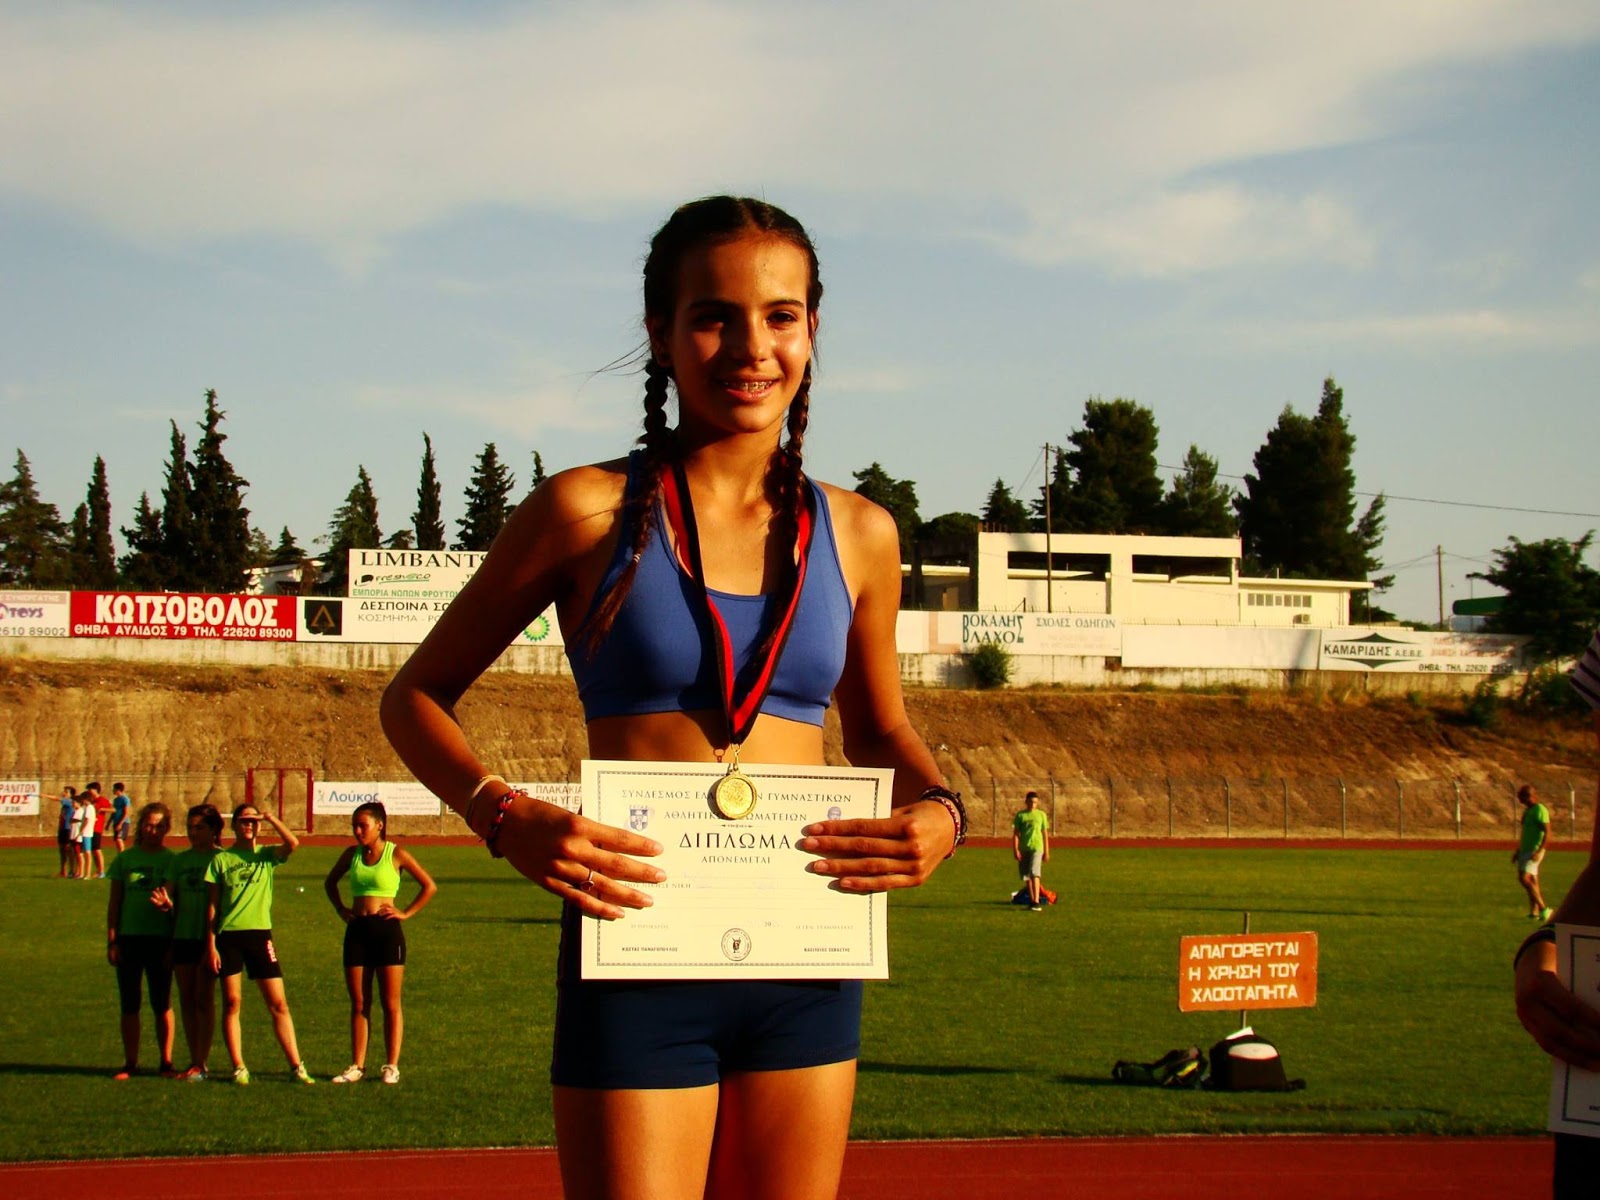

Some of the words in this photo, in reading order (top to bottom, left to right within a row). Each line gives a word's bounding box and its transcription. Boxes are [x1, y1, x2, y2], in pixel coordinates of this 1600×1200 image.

[352, 588, 389, 596] ΕΜΠΟΡΙΑ
[95, 595, 278, 627] ΚΩΤΣΟΒΟΛΟΣ
[360, 601, 428, 611] ΔΕΣΠΟΙΝΑ
[358, 613, 418, 622] ΚΟΣΜΗΜΑ
[1036, 617, 1071, 628] ΣΧΟΛΕΣ
[1075, 617, 1116, 628] ΟΔΗΓΩΝ
[0, 626, 25, 636] 610
[29, 627, 66, 636] 89002
[74, 624, 110, 635] ΘΗΒΑ
[115, 625, 168, 636] ΑΥΛΙΔΟΣ
[173, 626, 188, 636] 79
[193, 626, 220, 637] ΤΗΛ.
[222, 626, 257, 638] 22620
[259, 627, 293, 638] 89300
[1323, 645, 1392, 656] ΚΑΜΑΡΙΔΗΣ
[329, 790, 379, 803] Λούκος
[621, 789, 690, 799] ΣΥΝΔΕΣΜΟΣ
[768, 792, 851, 802] ΓΥΜΝΑΣΤΙΚΩΝ
[745, 812, 807, 821] ΩΜΑΤΕΙΩΝ
[679, 832, 790, 849] ΔΙΠΛΩΜΑ
[702, 855, 771, 864] ΑΠΟΝΕΜΕΤΑΙ
[1189, 942, 1299, 959] ΑΠΑΓΟΡΕΥΤΑΙ
[1188, 966, 1201, 981] Η
[1207, 964, 1261, 980] ΧΡΗΣΗ
[1267, 962, 1300, 978] ΤΟΥ
[1191, 984, 1298, 1003] ΧΛΟΟΤΑΠΗΤΑ
